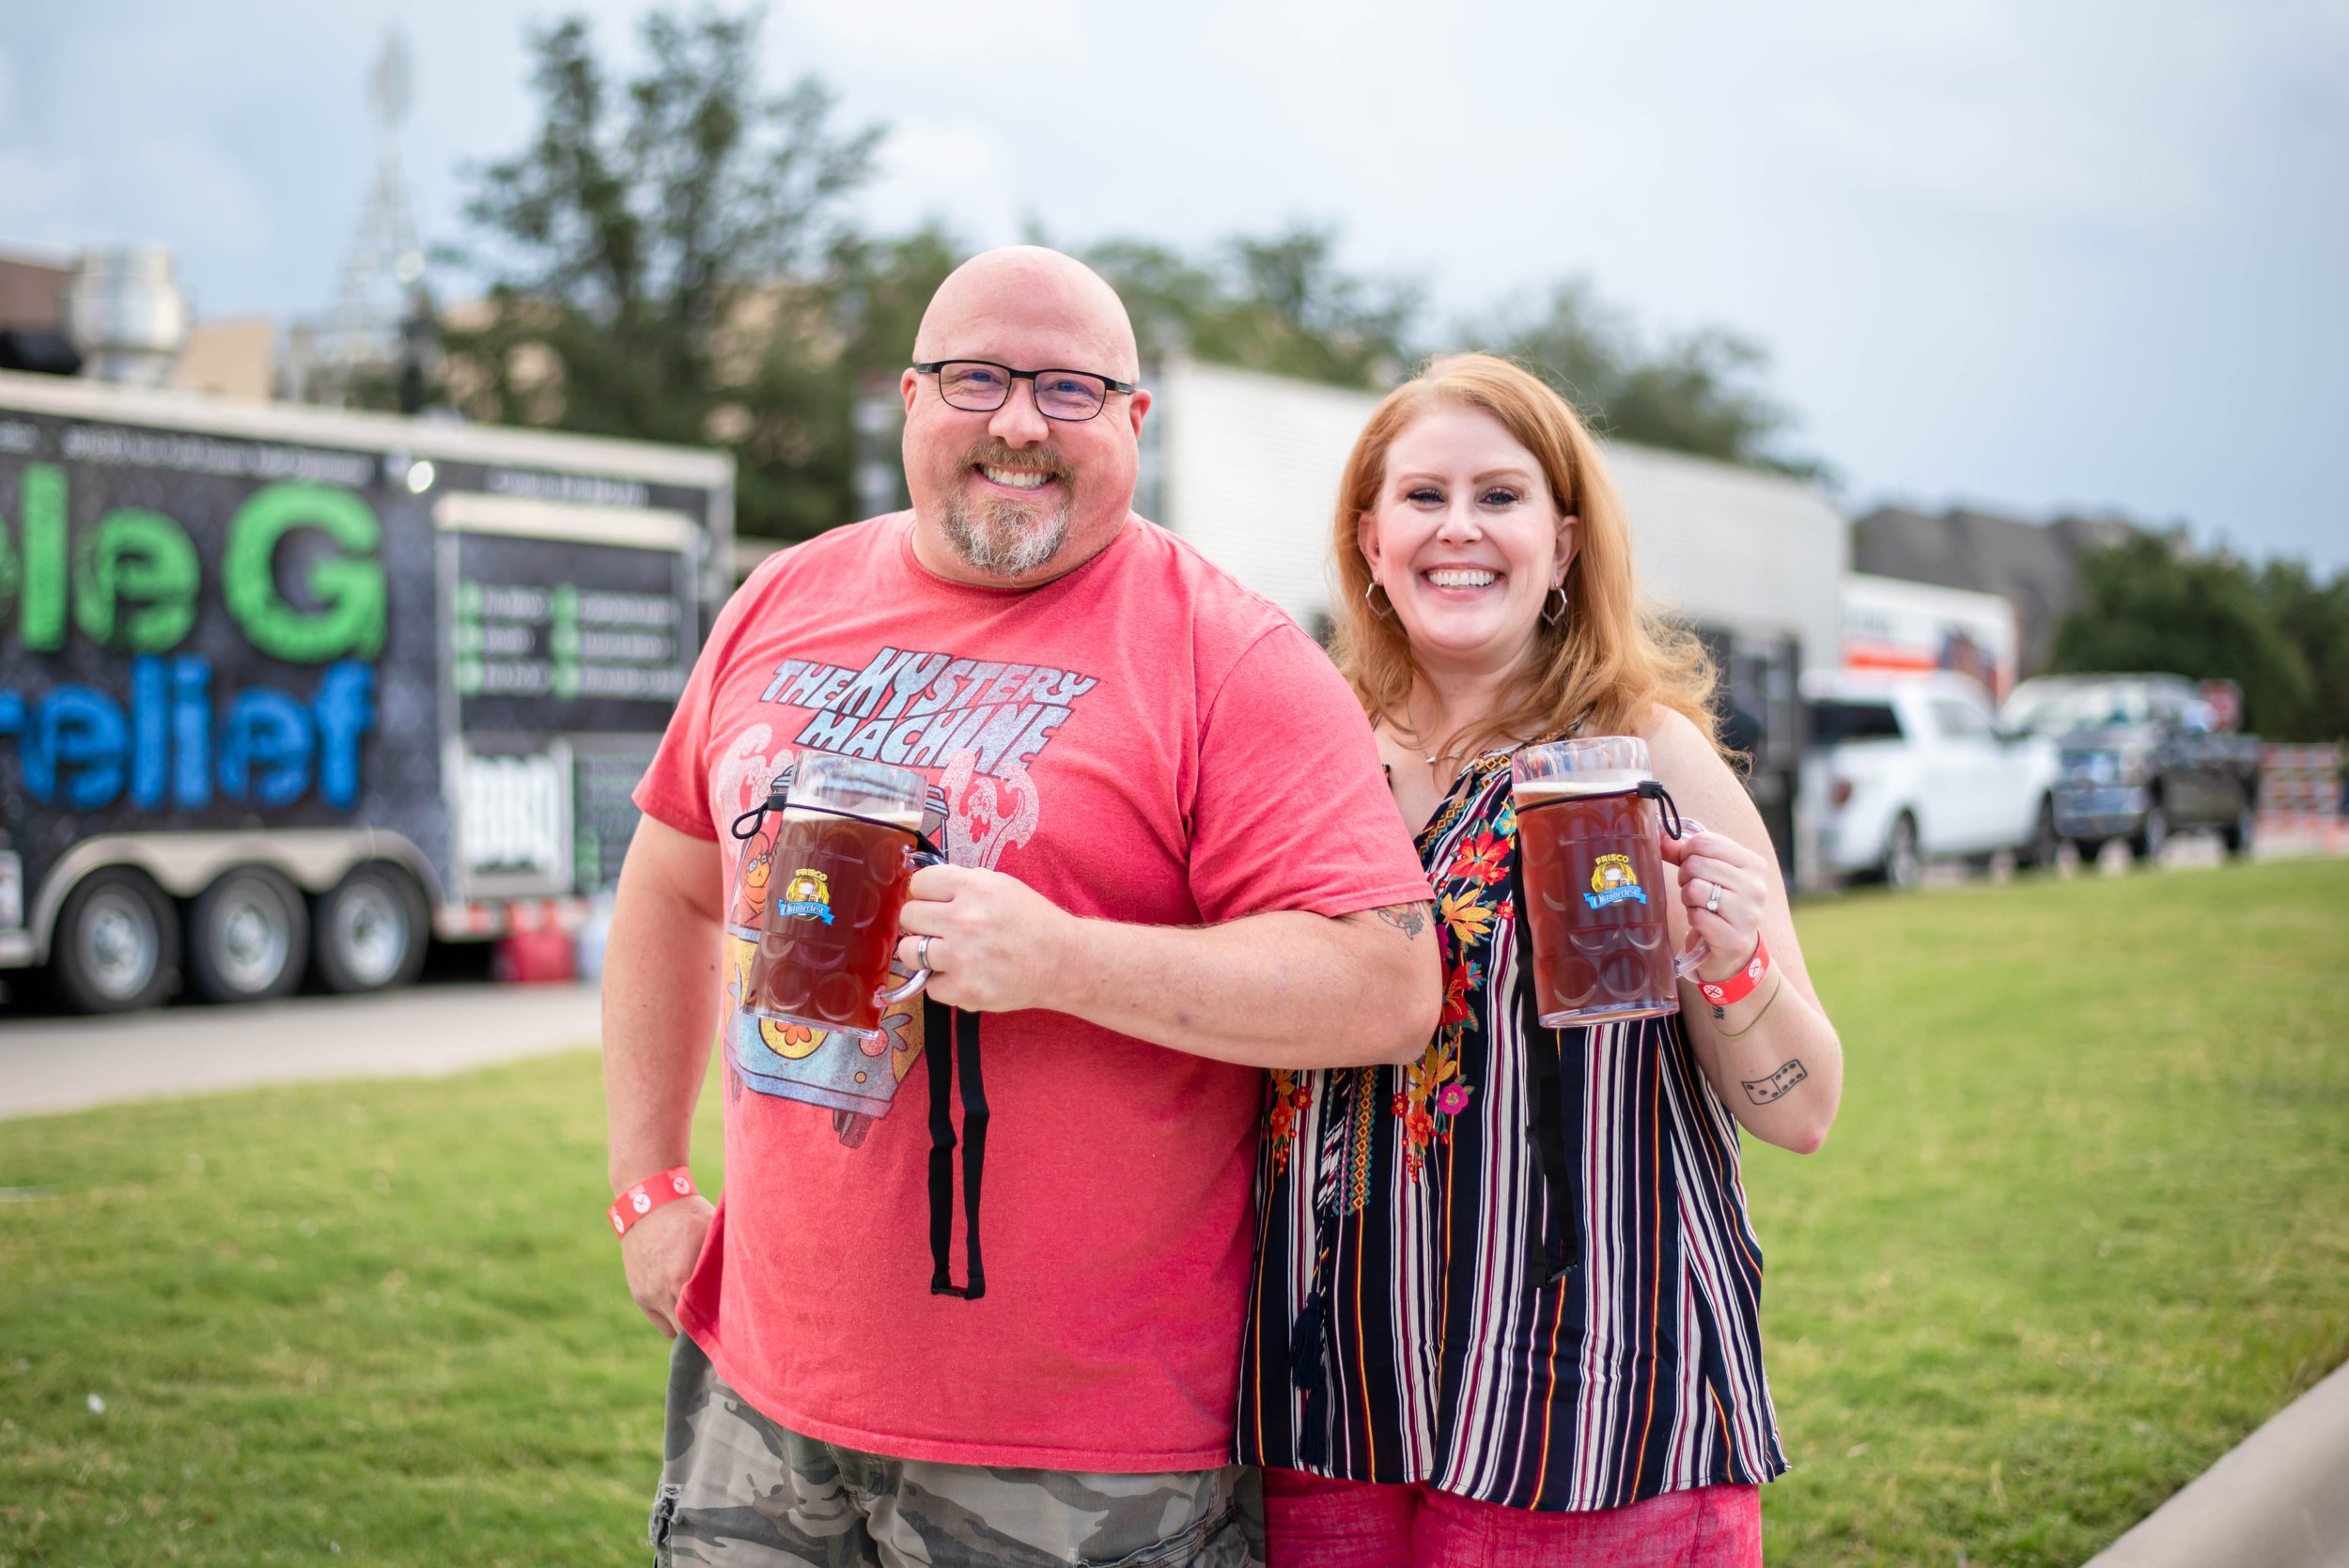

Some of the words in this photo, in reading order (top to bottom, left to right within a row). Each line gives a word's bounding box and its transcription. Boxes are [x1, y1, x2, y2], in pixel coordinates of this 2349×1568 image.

[0, 463, 200, 655] le
[224, 480, 386, 663] G
[758, 658, 862, 710] THE
[825, 646, 1101, 720] MYSTERY
[792, 703, 1077, 780] MACHINE
[1595, 853, 1629, 864] FRISCO
